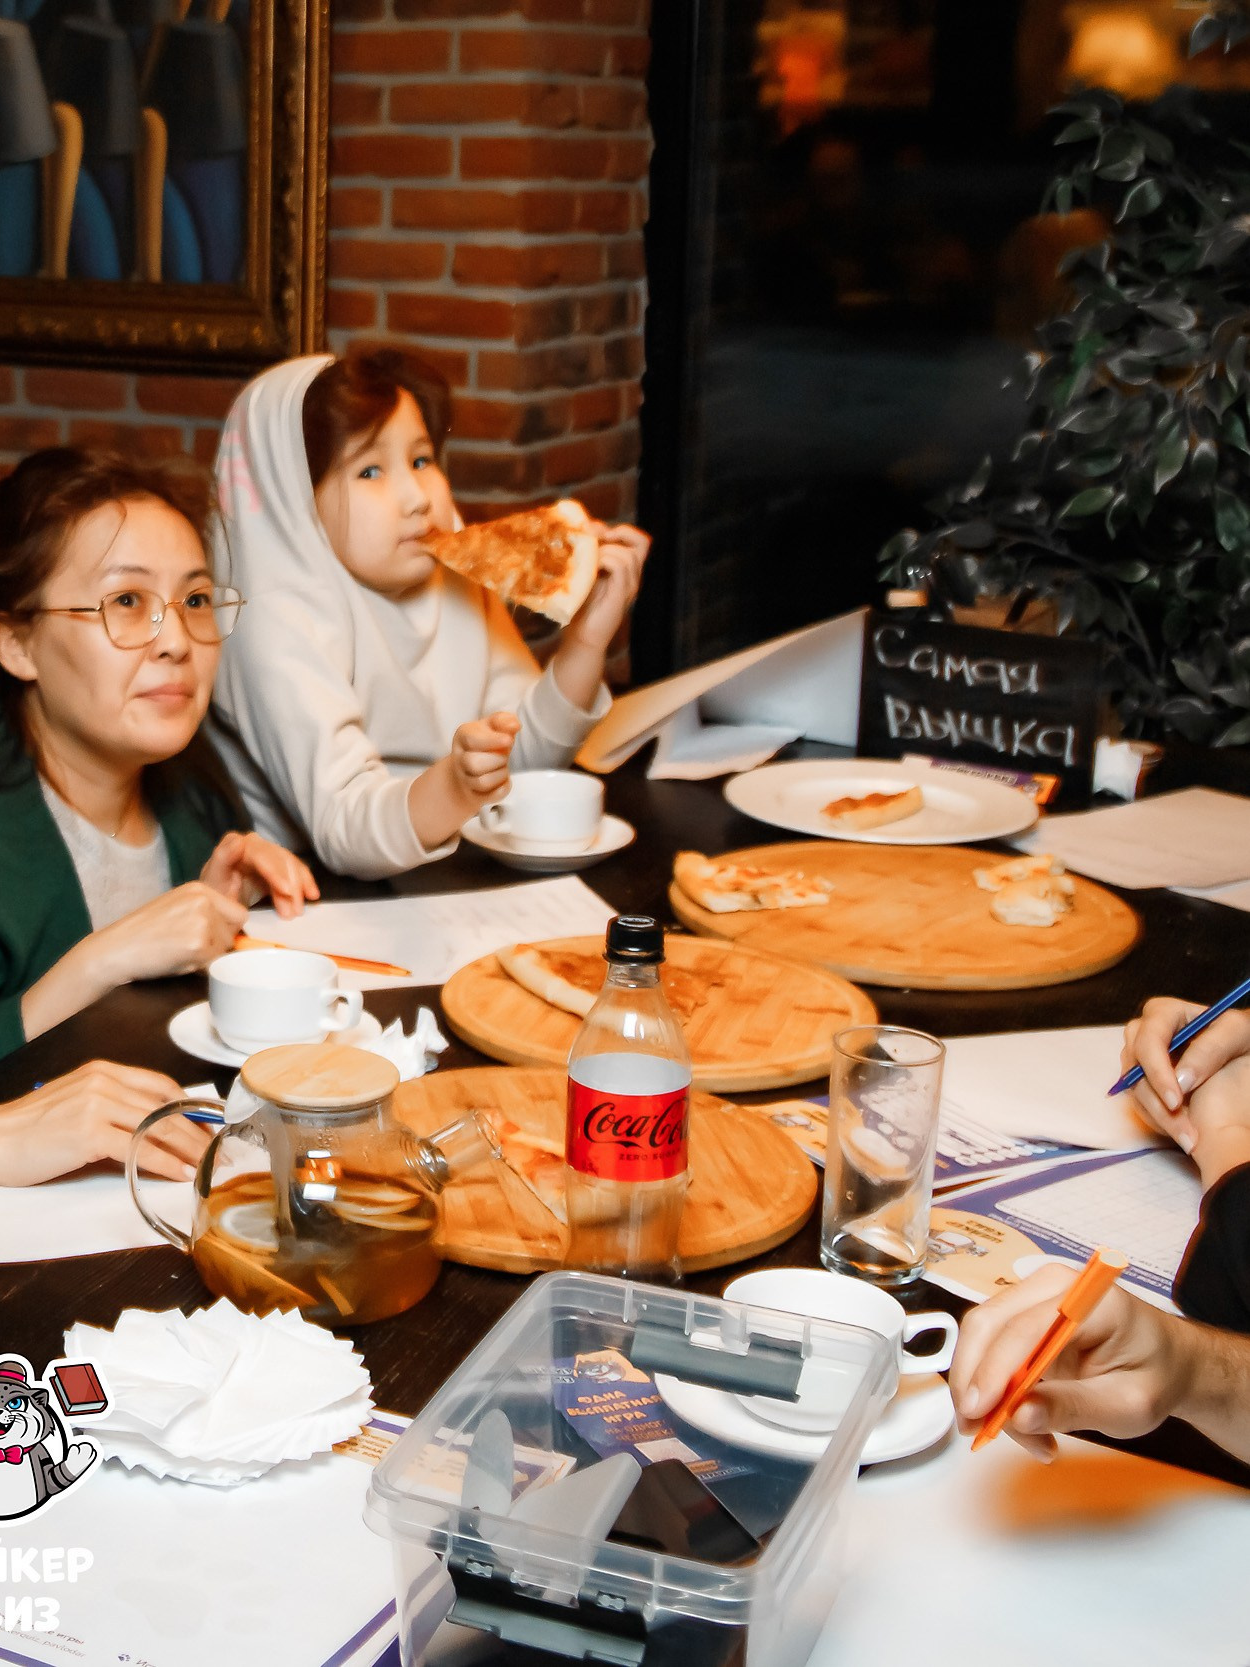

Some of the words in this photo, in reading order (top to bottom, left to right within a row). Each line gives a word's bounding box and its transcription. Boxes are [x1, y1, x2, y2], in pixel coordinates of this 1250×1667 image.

[874, 625, 1039, 694] Самая
[884, 694, 1075, 768] Вышка
[618, 1153, 648, 1161] ZERO
[577, 1390, 627, 1404] ОДНА
[603, 1410, 648, 1423] ИГРА
[56, 1632, 85, 1645] игры
